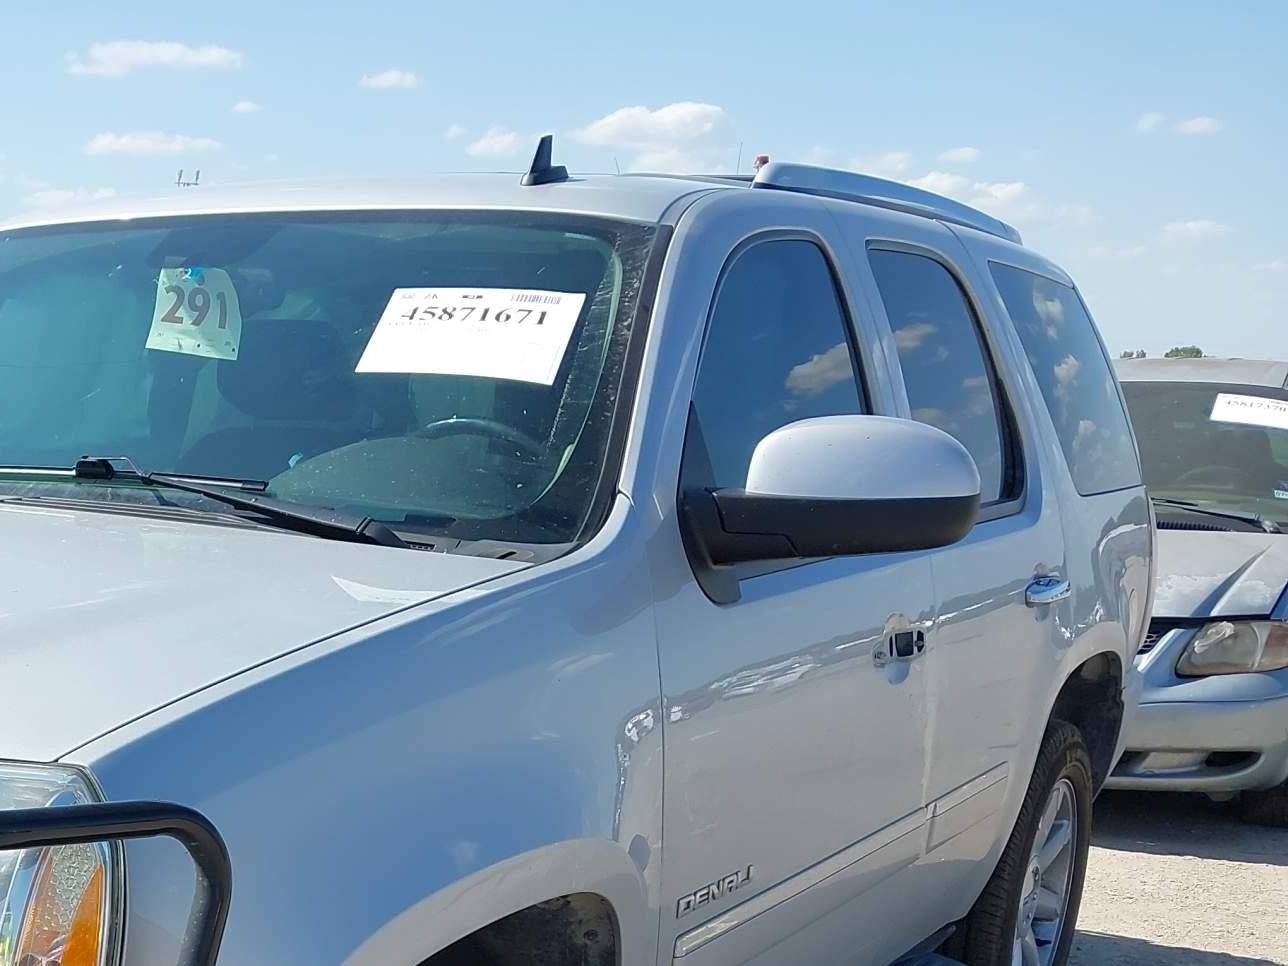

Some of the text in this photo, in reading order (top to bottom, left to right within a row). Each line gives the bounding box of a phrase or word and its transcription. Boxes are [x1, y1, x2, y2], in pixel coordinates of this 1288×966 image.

[160, 285, 227, 329] 291
[401, 306, 549, 325] 45871671
[675, 864, 755, 919] DENALI
